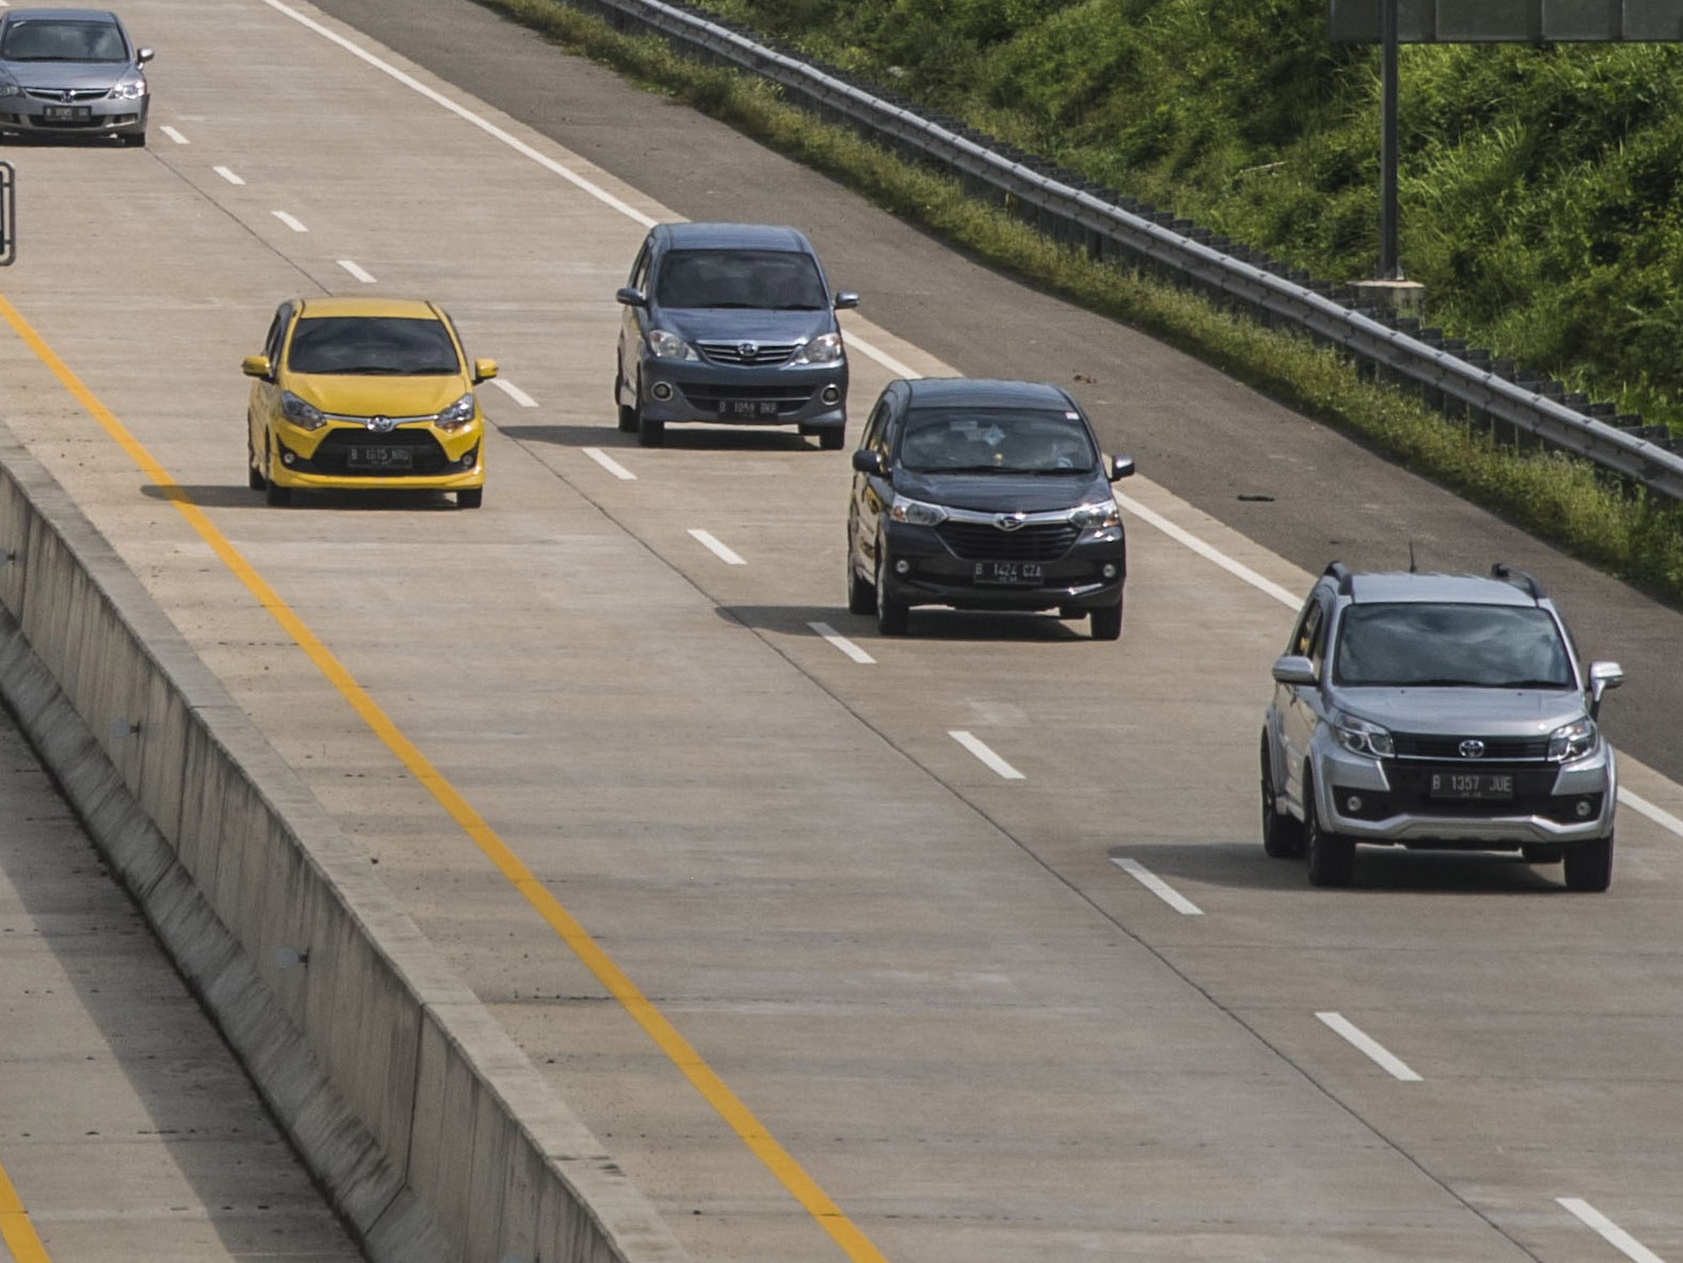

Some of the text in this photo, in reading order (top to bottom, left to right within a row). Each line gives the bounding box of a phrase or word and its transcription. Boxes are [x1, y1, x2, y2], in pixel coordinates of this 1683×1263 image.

[351, 448, 358, 460] B
[976, 562, 983, 575] B
[1432, 774, 1512, 792] B 1357 JUE
